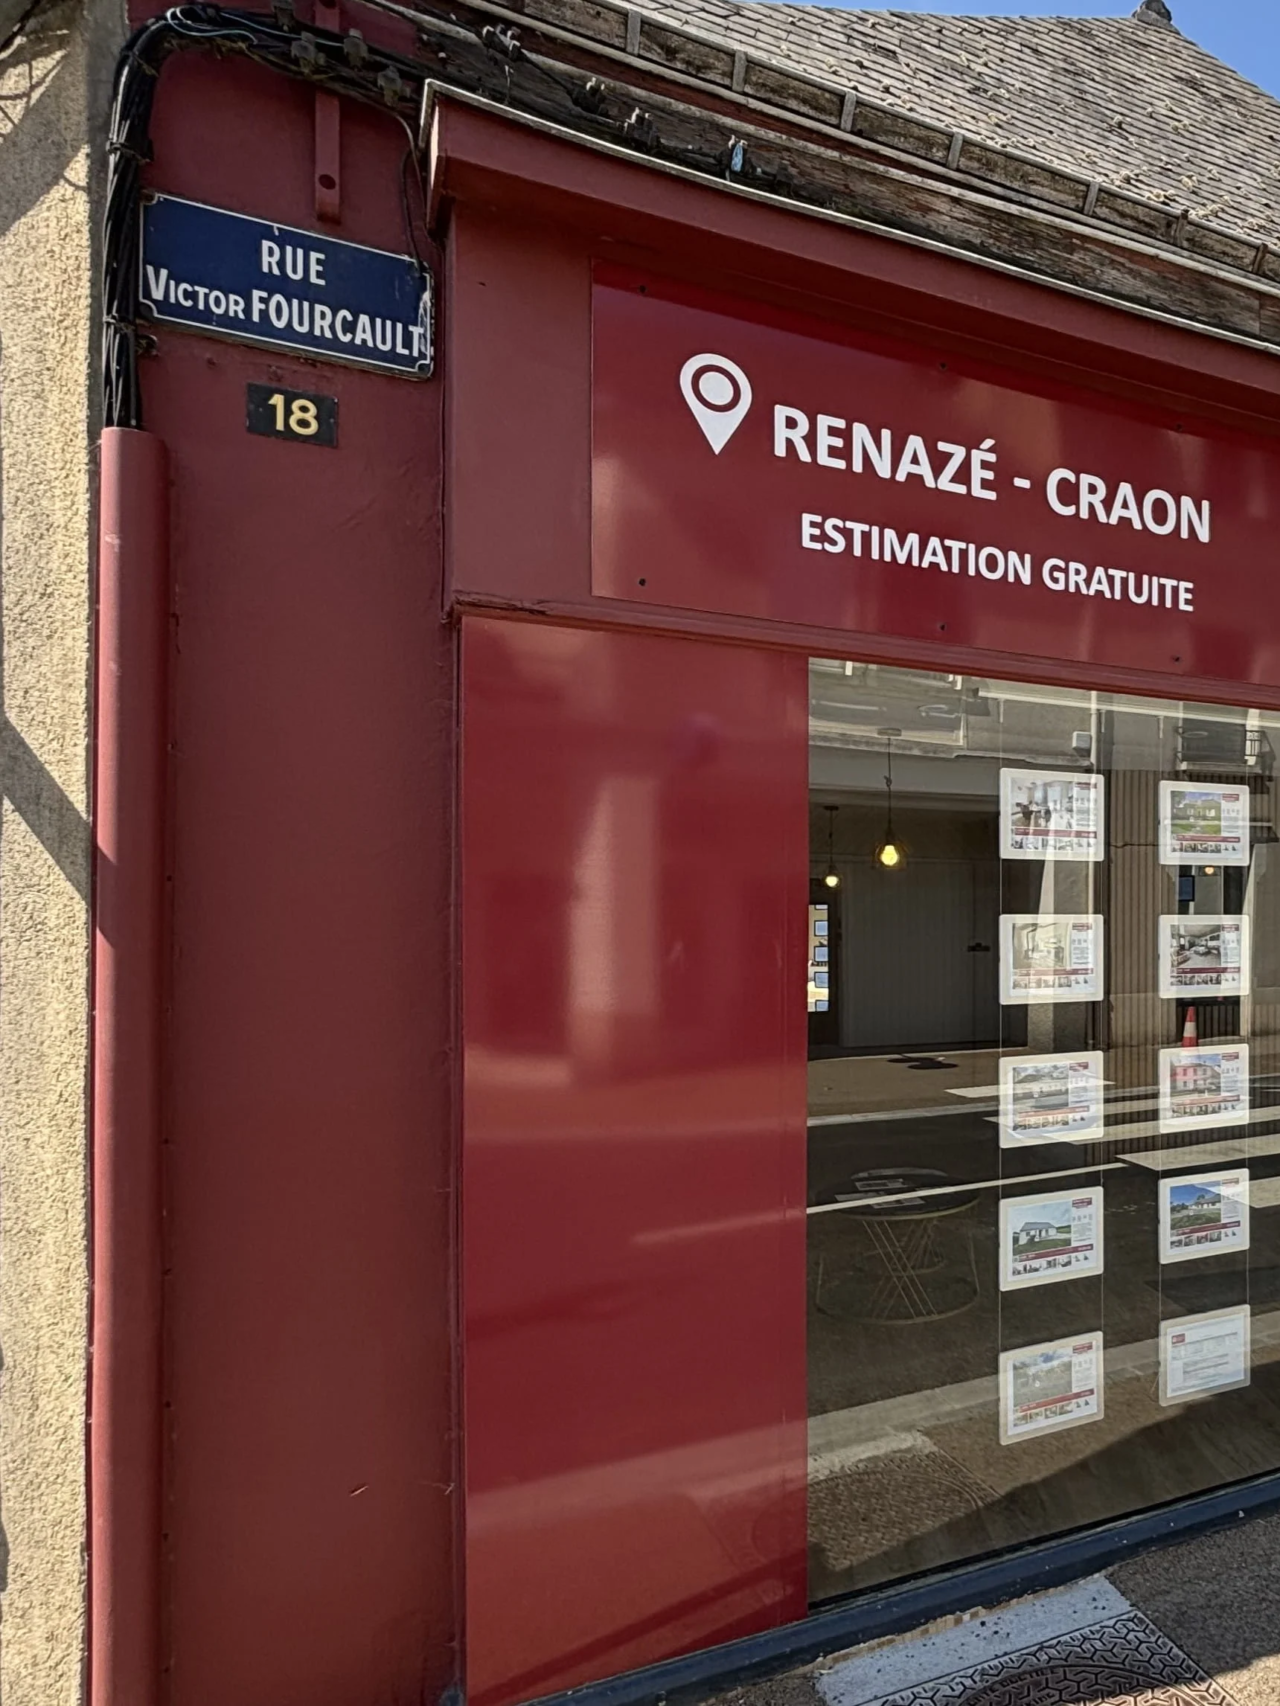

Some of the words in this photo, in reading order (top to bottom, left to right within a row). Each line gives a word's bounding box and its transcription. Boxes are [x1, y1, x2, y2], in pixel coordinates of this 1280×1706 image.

[261, 239, 326, 286] RUE
[252, 289, 424, 358] FOURCAULT
[268, 394, 319, 436] 18
[773, 404, 997, 500] RENAZÉ
[1013, 477, 1031, 489] -
[1046, 467, 1211, 543] CRAON
[801, 512, 1031, 585] ESTIMATION
[1042, 557, 1194, 612] GRATUITE
